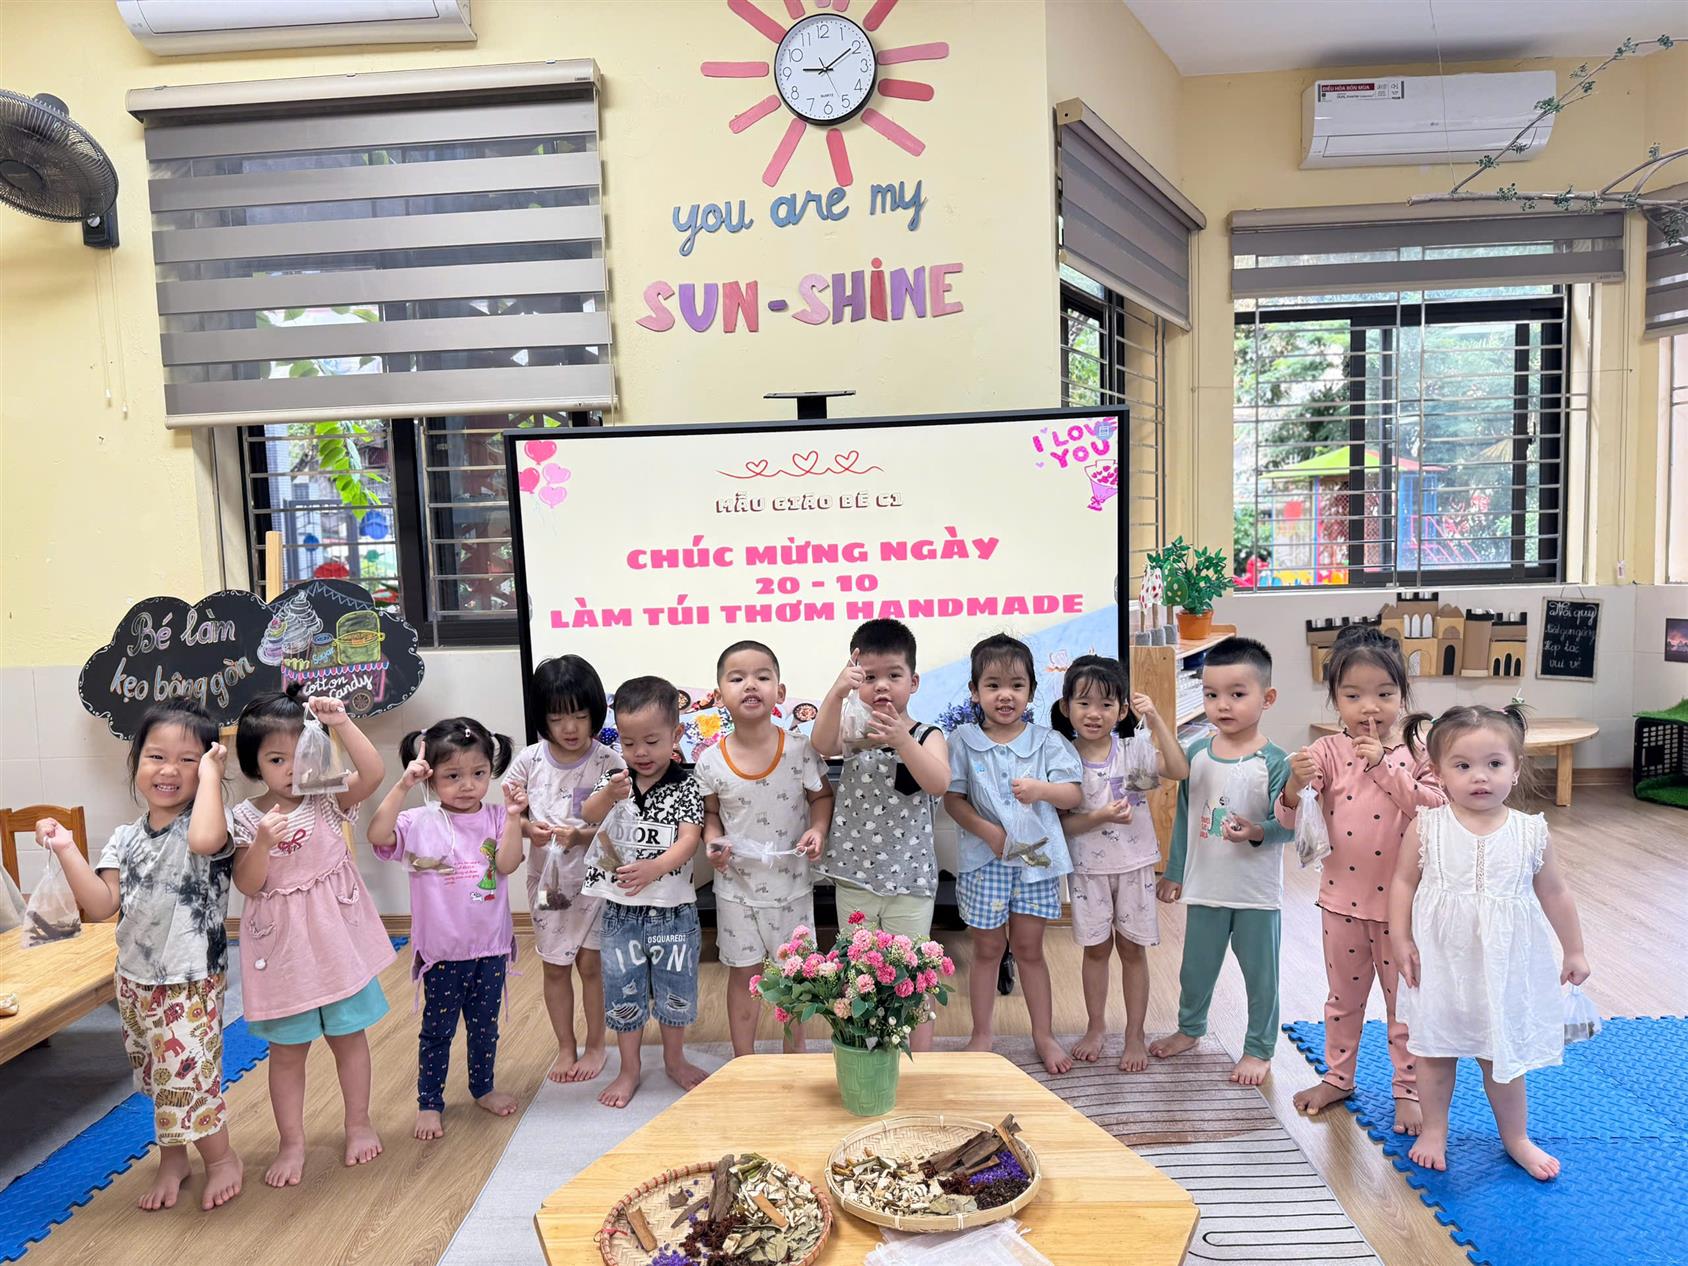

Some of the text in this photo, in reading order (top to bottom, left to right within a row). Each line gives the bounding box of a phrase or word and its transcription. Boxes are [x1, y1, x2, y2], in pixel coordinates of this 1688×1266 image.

[816, 24, 830, 39] 12
[839, 27, 844, 41] 1
[801, 32, 811, 47] 11
[851, 40, 862, 54] 2
[788, 48, 803, 62] 10
[860, 58, 869, 73] 3
[782, 66, 792, 81] 9
[790, 85, 799, 100] 8
[854, 79, 863, 93] 4
[806, 97, 815, 112] 7
[823, 101, 834, 115] 6
[841, 94, 851, 108] 5
[672, 179, 928, 257] you are my
[1033, 436, 1044, 453] I
[1050, 440, 1110, 468] YOU
[716, 491, 765, 513] MẪU
[839, 491, 869, 508] BÉ
[876, 491, 903, 507] C1
[627, 526, 999, 570] CHÚC MỪNG NGÀY
[756, 576, 800, 595] 20
[836, 574, 878, 592] 10
[550, 594, 1083, 629] LÀM TÚI THƠM HANDMADE
[127, 607, 236, 657] Bé làm
[110, 657, 149, 703] kẹo
[153, 665, 208, 709] bông
[611, 824, 661, 845] DIOR
[615, 940, 687, 974] ICON
